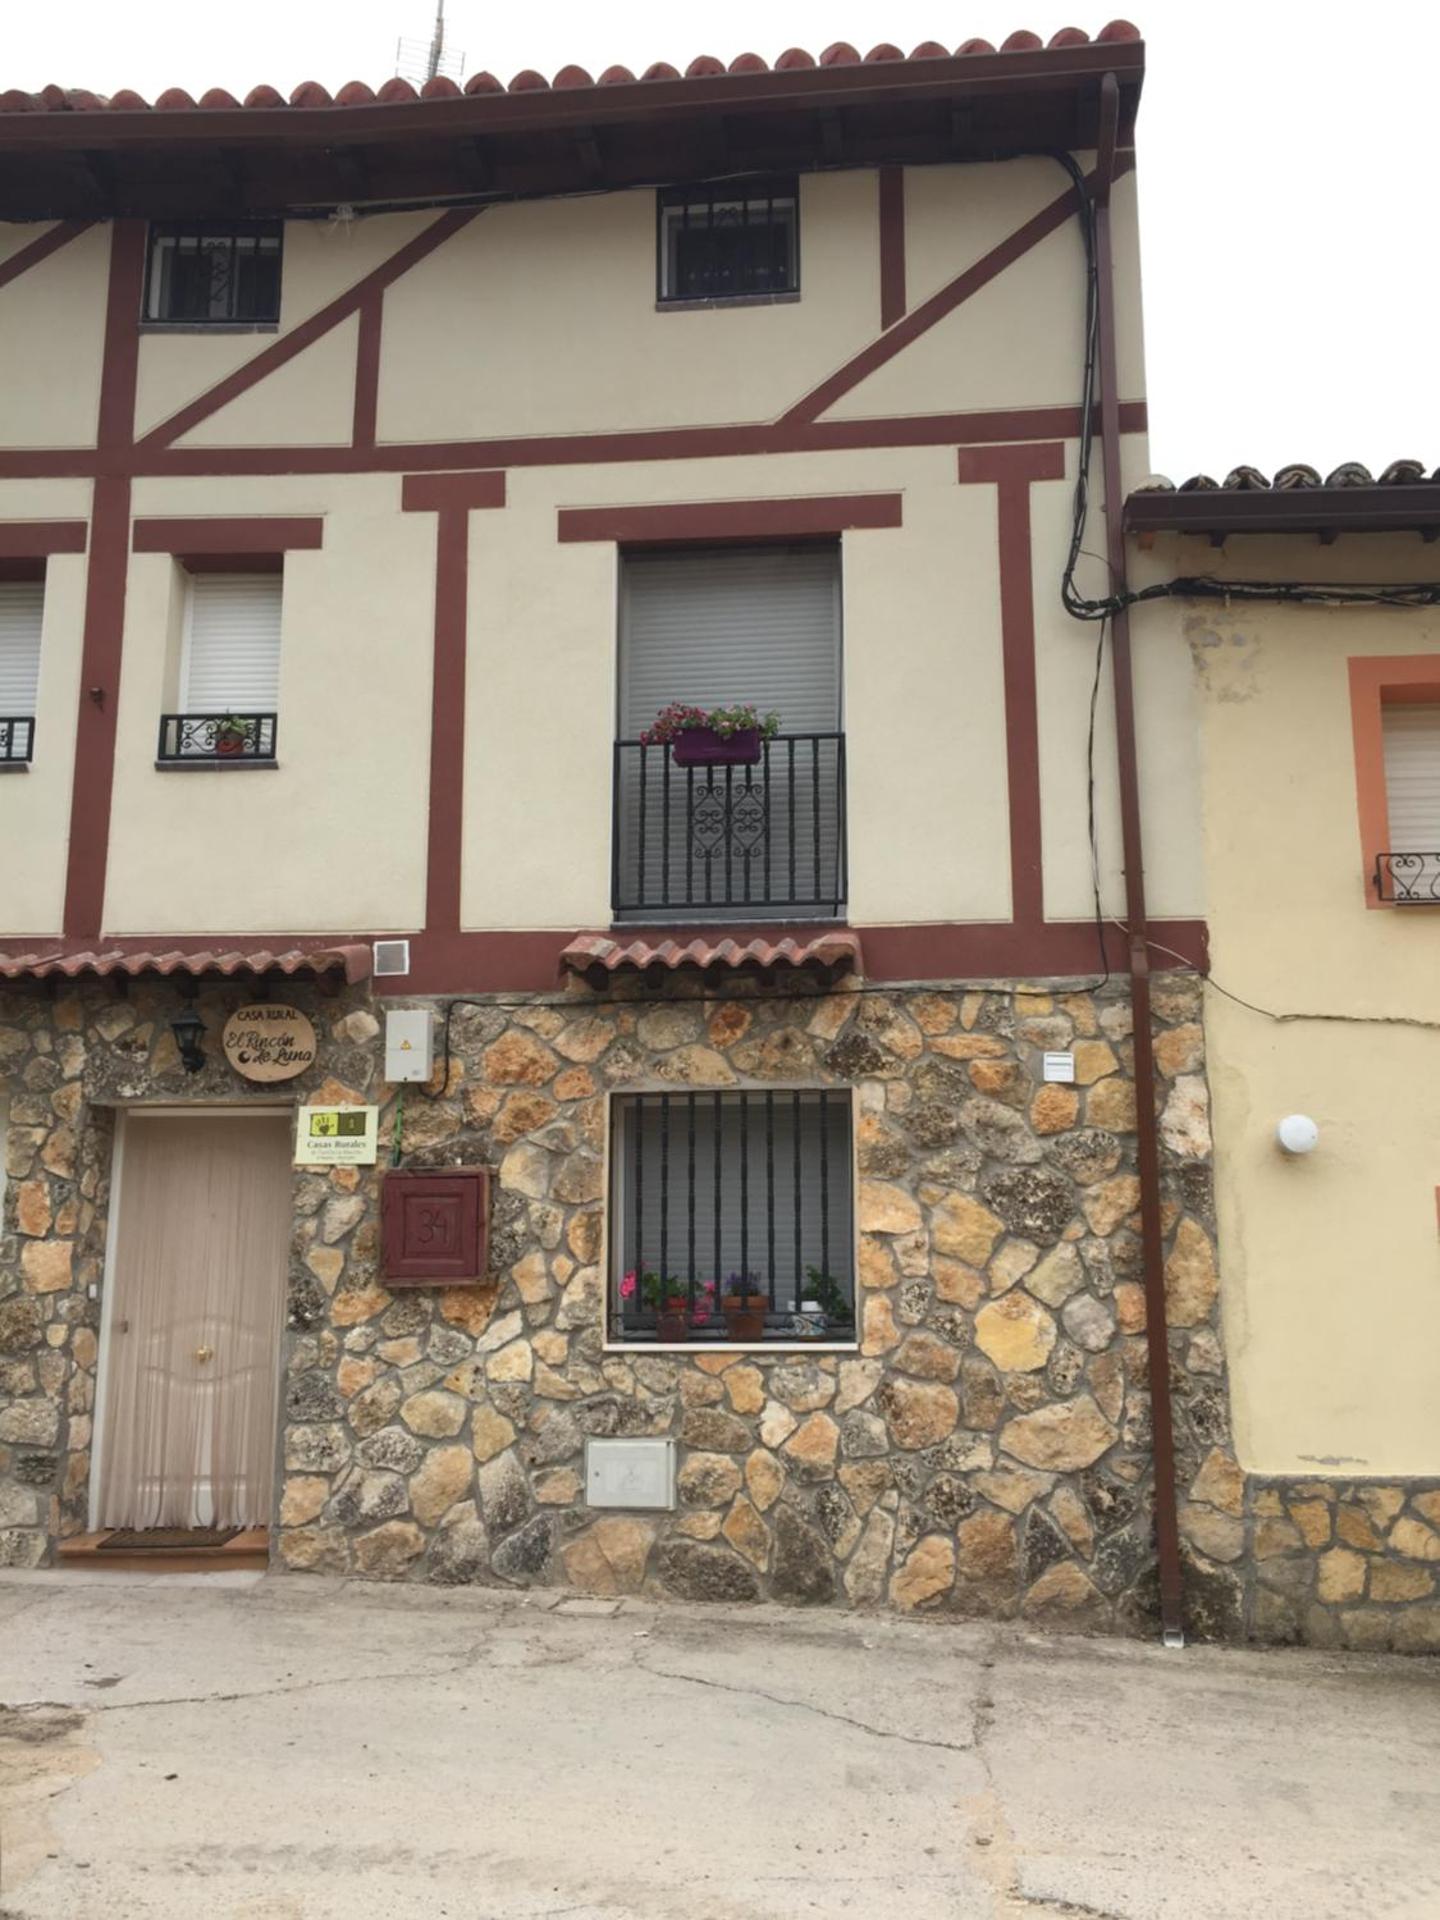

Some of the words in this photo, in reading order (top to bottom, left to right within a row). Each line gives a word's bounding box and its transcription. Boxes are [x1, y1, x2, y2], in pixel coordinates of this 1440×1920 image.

[237, 1011, 264, 1021] CASA
[266, 1009, 298, 1020] RURAL
[226, 1031, 244, 1048] El
[246, 1030, 295, 1051] Rincón
[253, 1049, 271, 1065] de
[272, 1047, 312, 1066] Luna
[307, 1140, 332, 1148] Casas
[334, 1139, 366, 1148] Rurales
[418, 1209, 448, 1244] 34
